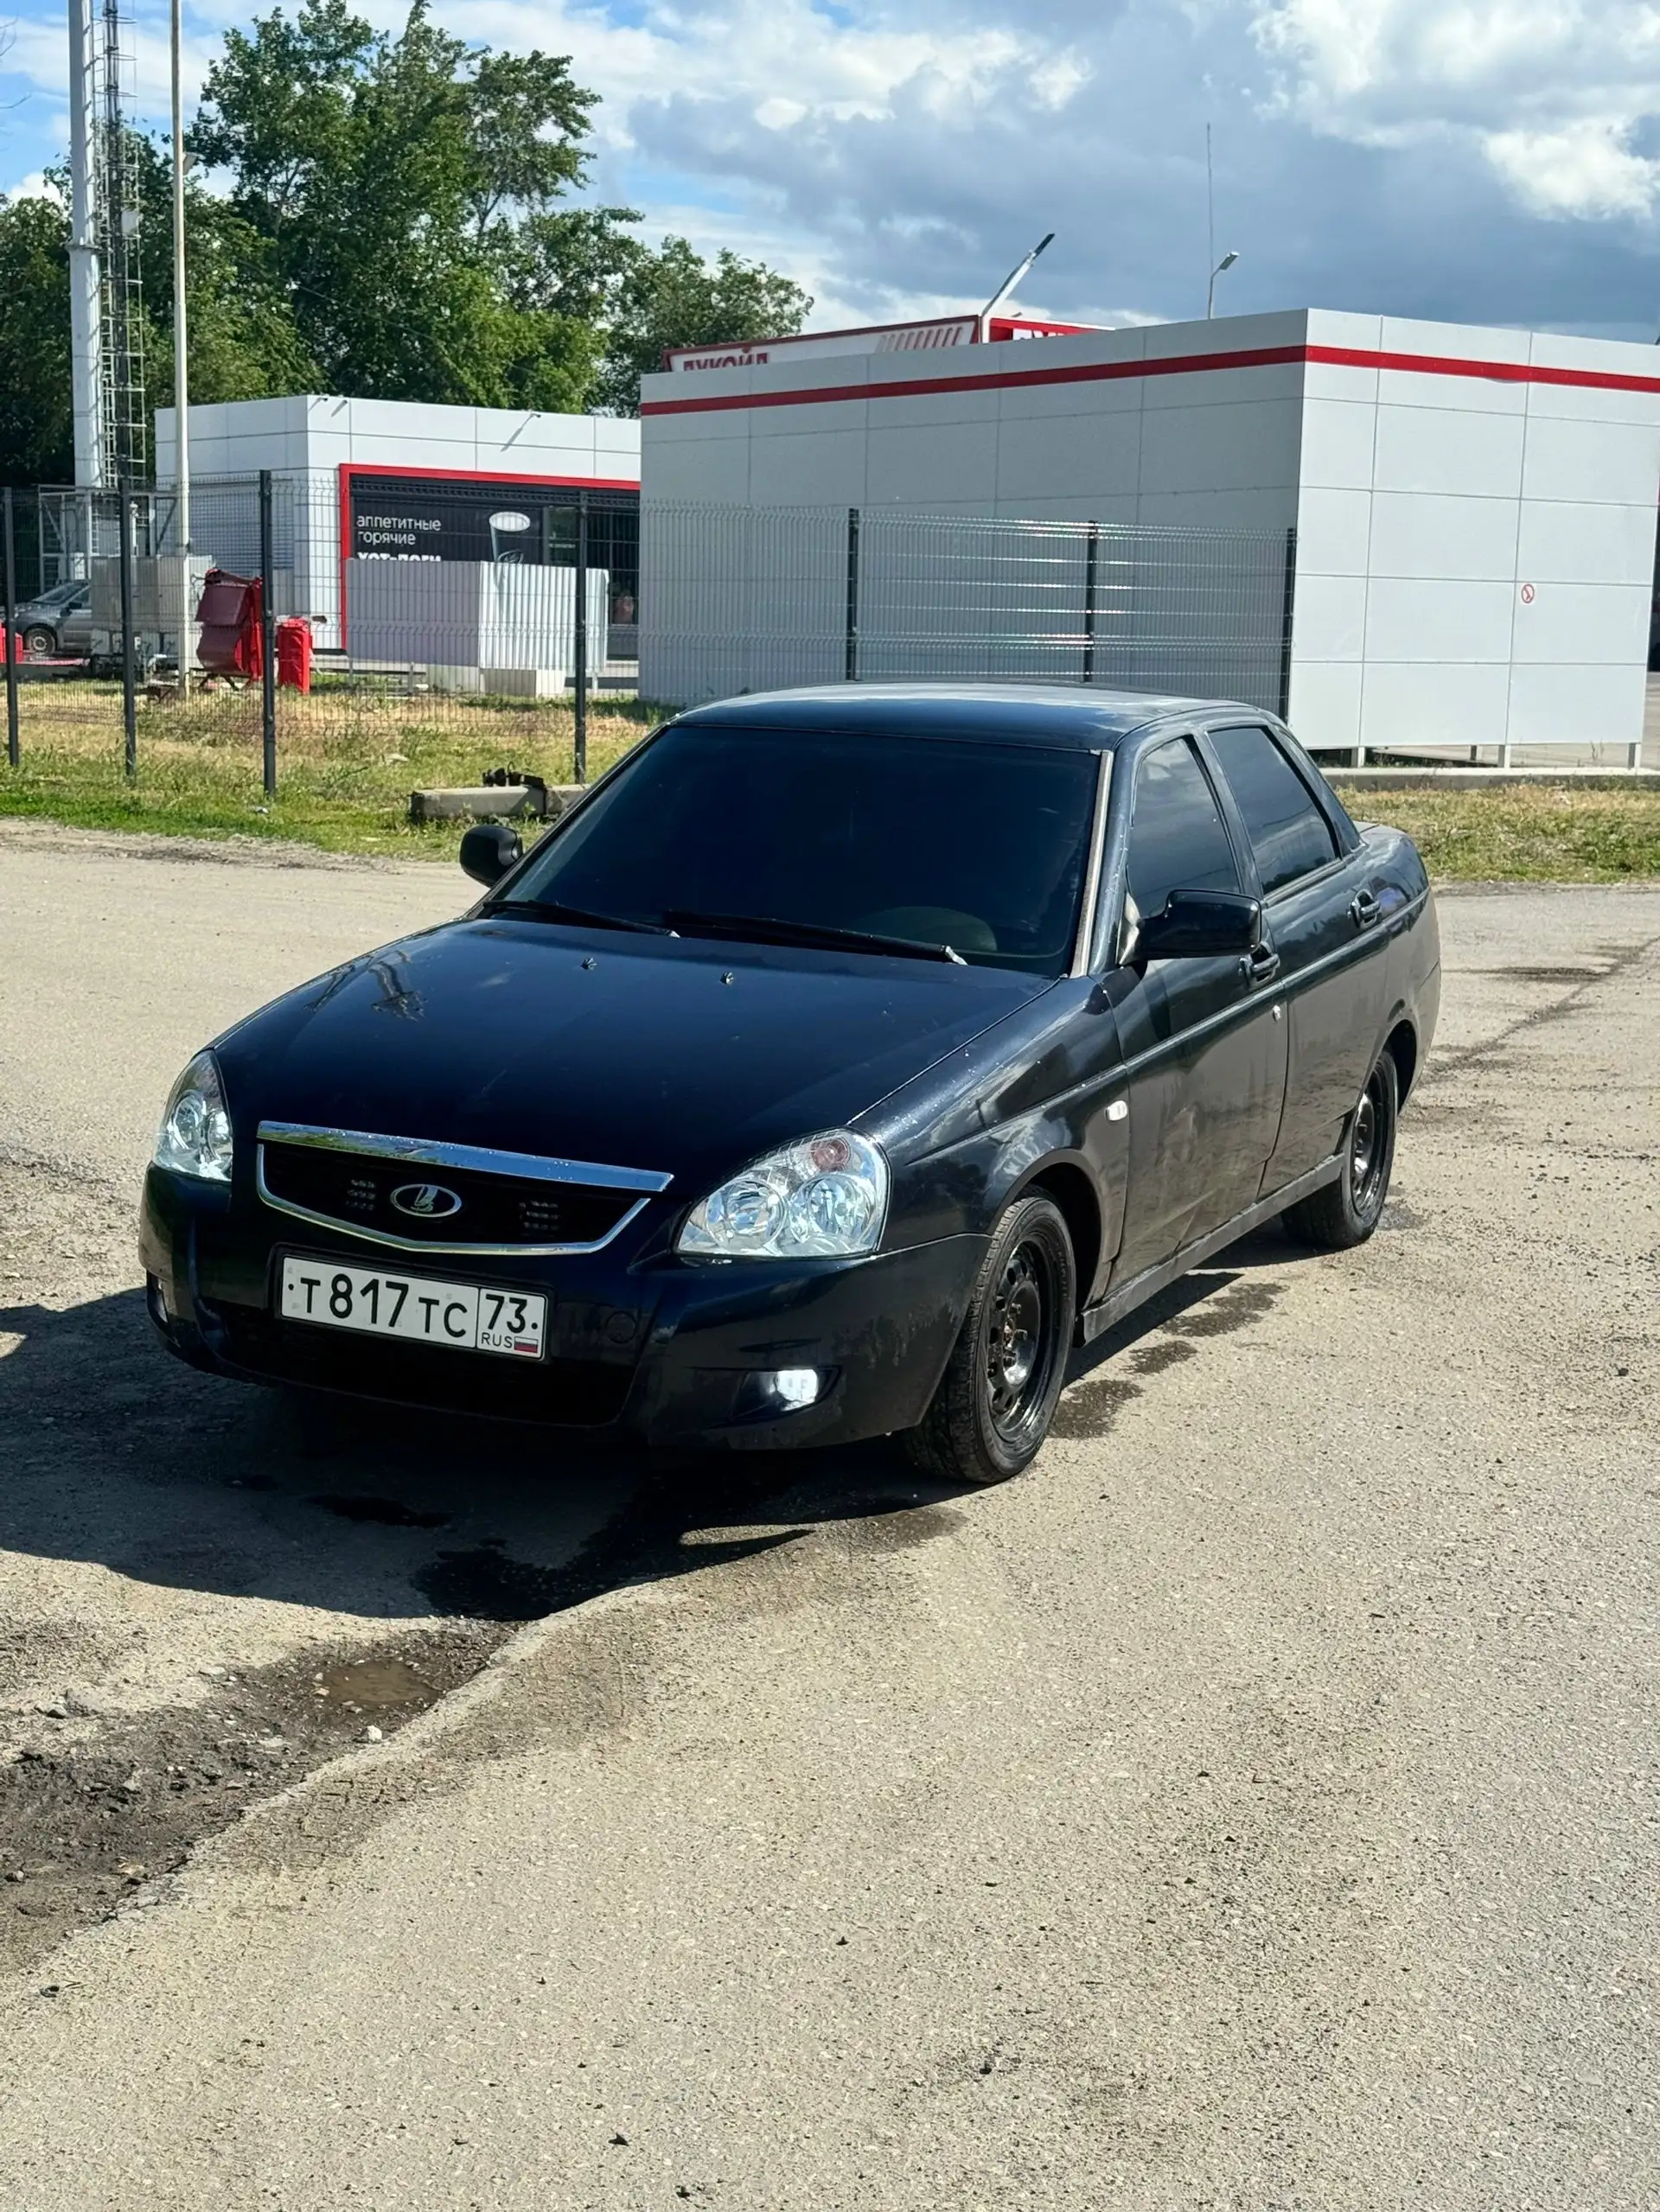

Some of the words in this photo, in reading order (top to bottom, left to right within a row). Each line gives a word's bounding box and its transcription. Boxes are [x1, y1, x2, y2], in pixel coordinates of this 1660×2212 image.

[356, 515, 442, 531] аппетитные
[357, 531, 416, 546] горячие
[300, 1273, 468, 1337] Т817ТС
[485, 1293, 527, 1334] 73
[481, 1331, 513, 1348] RUS
